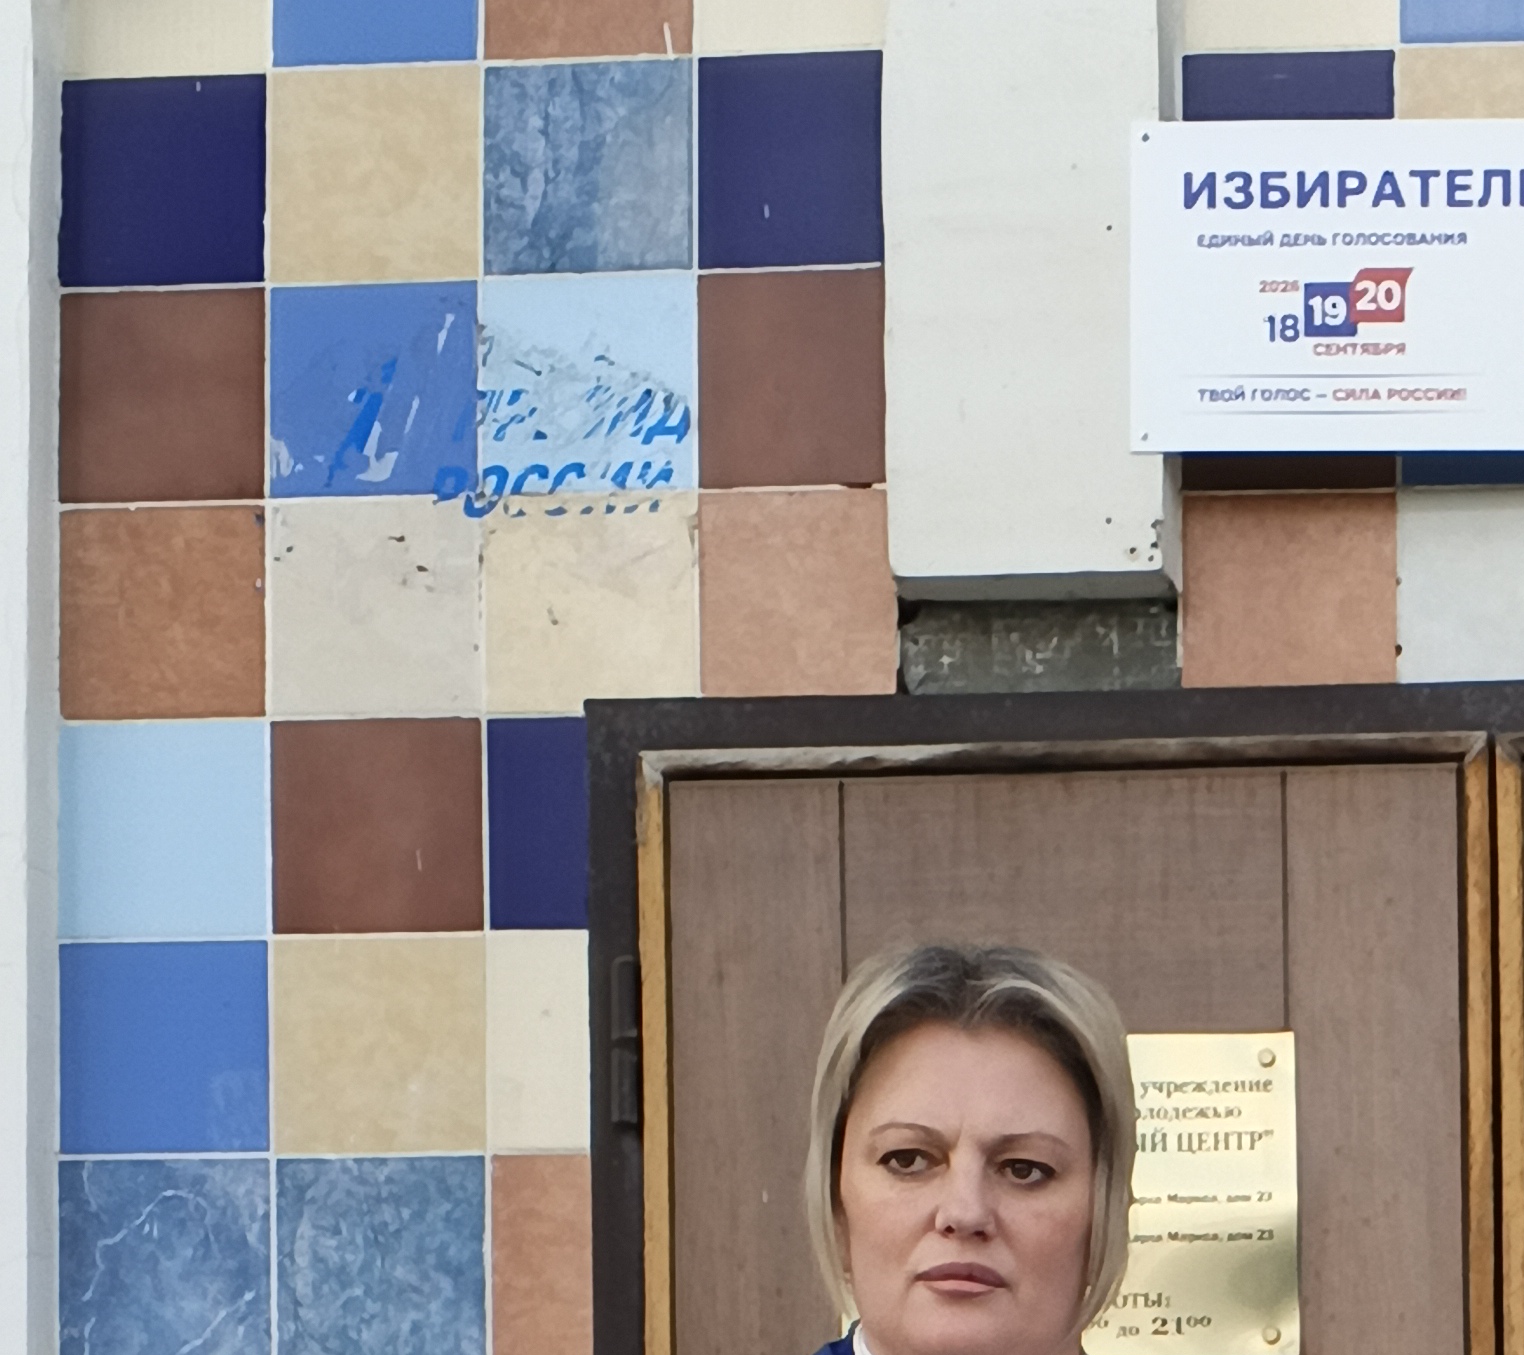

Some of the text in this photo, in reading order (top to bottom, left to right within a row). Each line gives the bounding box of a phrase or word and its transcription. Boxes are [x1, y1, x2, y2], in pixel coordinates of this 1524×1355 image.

[1196, 230, 1468, 249] ЕДИНЫЙ ДЕНЬ ГОЛОСОВАНИЯ
[1263, 279, 1402, 343] 18 19 20
[1312, 342, 1407, 357] СЕНТЯБРЯ
[1197, 384, 1246, 403] ТВОЙ
[1250, 387, 1312, 402] ГОЛОС
[1331, 387, 1382, 402] СИЛА
[1139, 1078, 1273, 1100] учреждение
[1115, 1325, 1140, 1339] до
